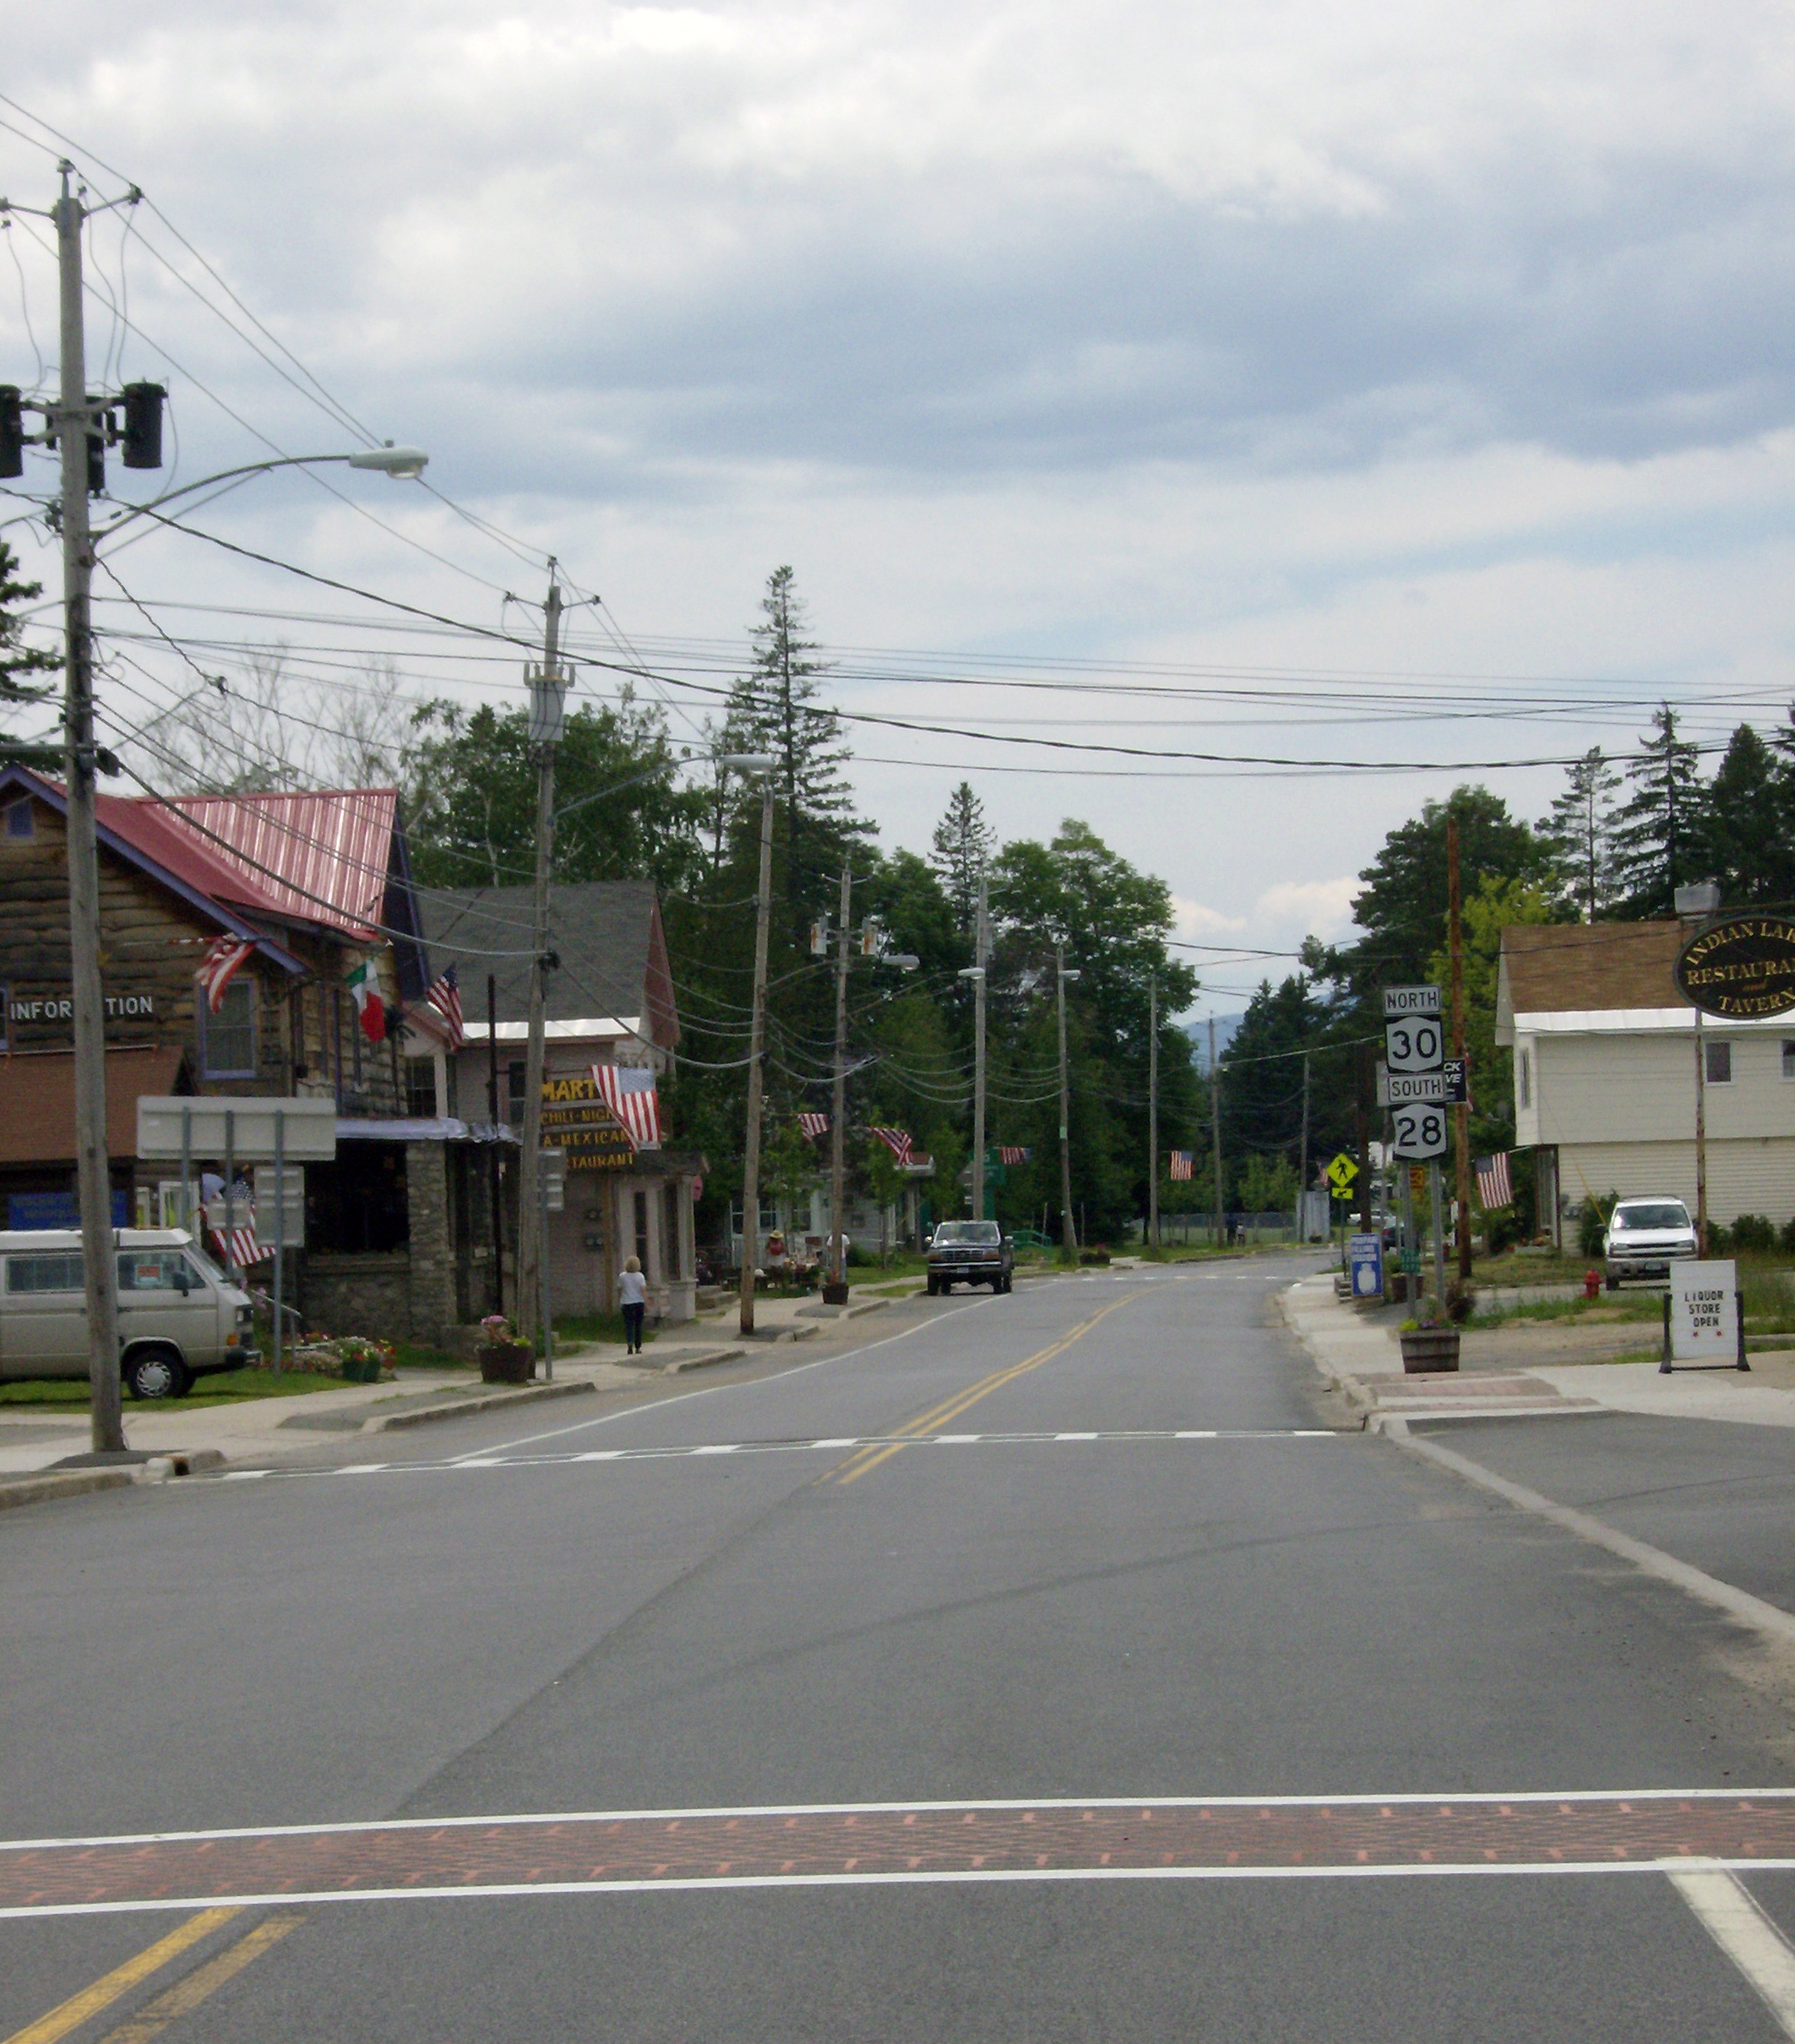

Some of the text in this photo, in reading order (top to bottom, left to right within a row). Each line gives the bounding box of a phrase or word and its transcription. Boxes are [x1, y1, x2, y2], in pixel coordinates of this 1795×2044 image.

[1686, 921, 1795, 965] INDIAN LAK
[1686, 957, 1795, 985] RESTAURA
[10, 996, 153, 1020] INFORTION
[1387, 992, 1437, 1009] NORTH
[1719, 987, 1795, 1013] TAVERN
[1392, 1028, 1437, 1060] 30
[541, 1078, 596, 1101] MART
[1391, 1079, 1441, 1096] SOUTH
[1398, 1115, 1442, 1147] 28
[1684, 1290, 1724, 1302] LIQUOR
[1689, 1303, 1721, 1314] STORE
[1693, 1316, 1719, 1328] OPEN
